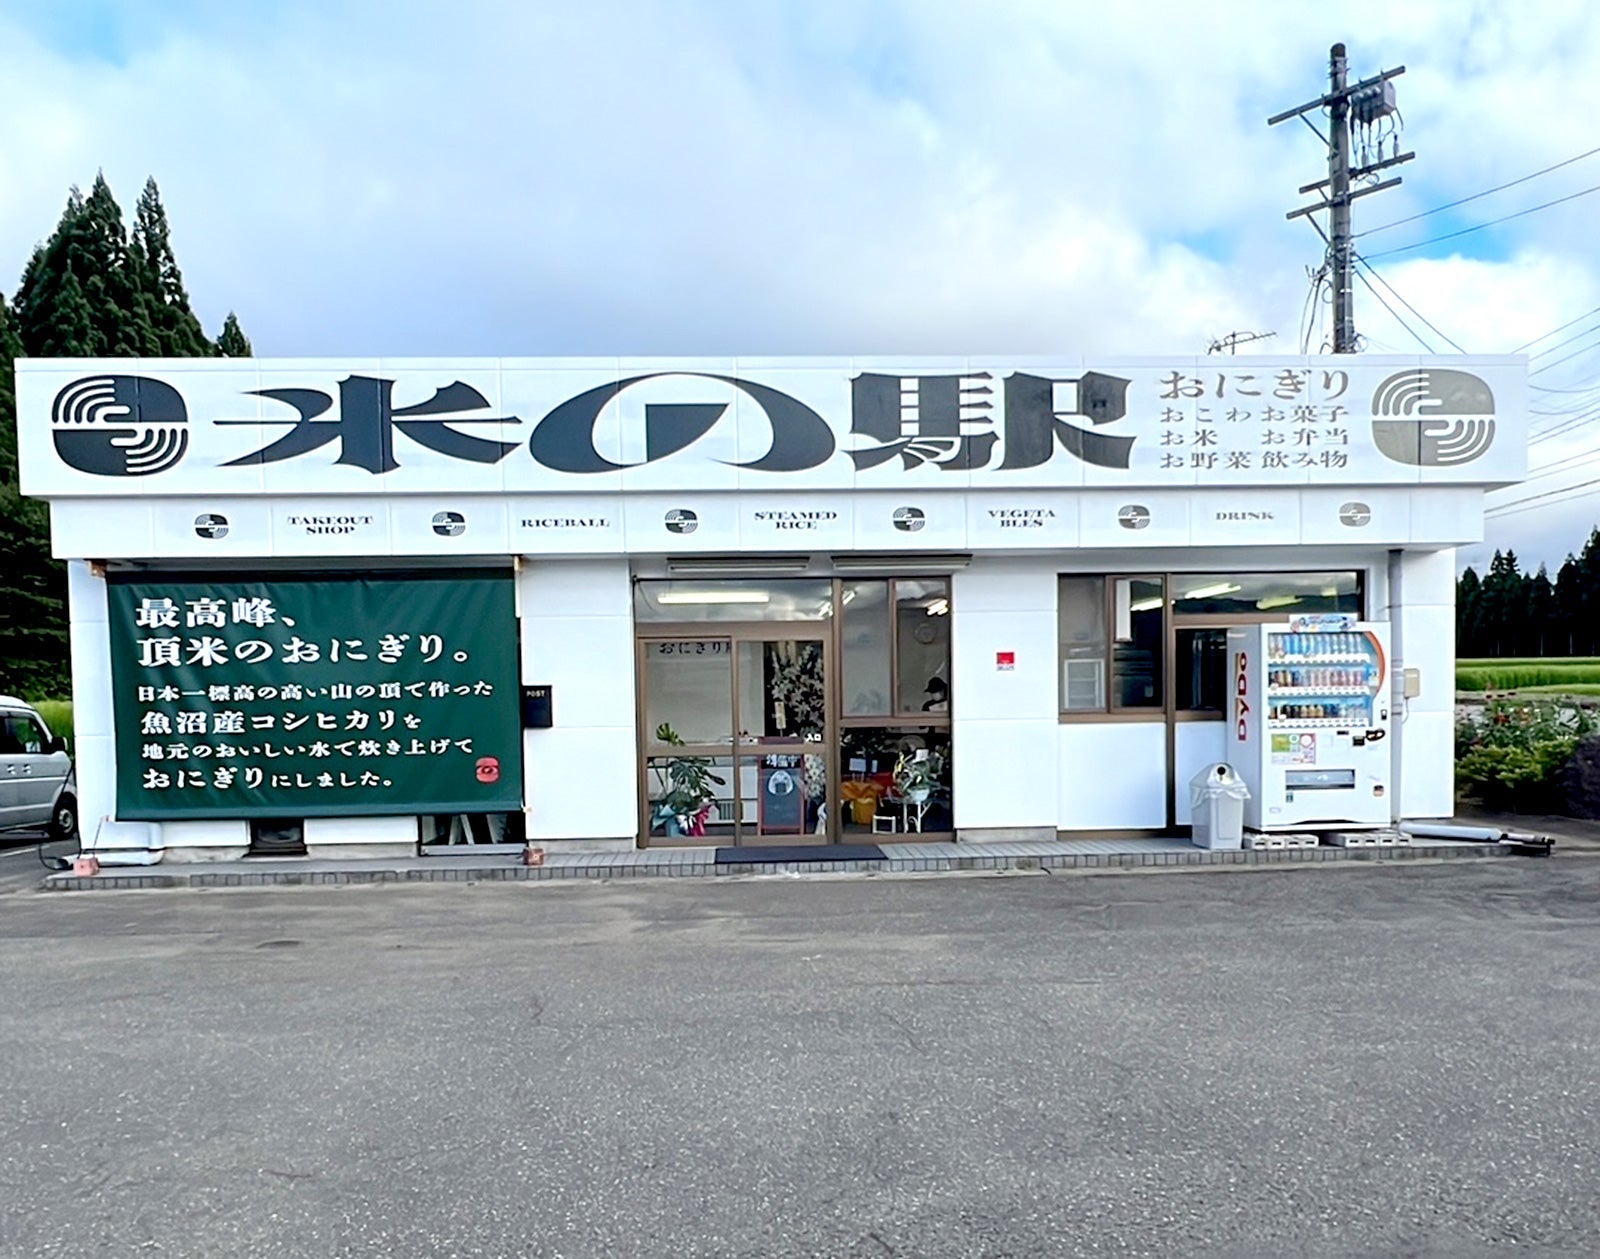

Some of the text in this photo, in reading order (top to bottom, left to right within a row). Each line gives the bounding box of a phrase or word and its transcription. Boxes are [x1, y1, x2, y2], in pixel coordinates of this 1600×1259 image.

[1159, 368, 1349, 401] おにぎり
[213, 370, 1137, 475] 米の駅
[1160, 405, 1349, 424] おこわ お菓子
[1160, 428, 1348, 447] お米 お弁当
[1160, 450, 1348, 470] お野菜 飲み物
[287, 516, 373, 525] TAKEOUT
[521, 518, 610, 528] RICEBALL
[754, 511, 837, 521] STEAMED
[987, 509, 1056, 518] VEGETA
[1215, 511, 1274, 521] DRINK
[306, 526, 355, 535] SHOP
[775, 521, 817, 530] RICE
[1000, 519, 1044, 528] BLES
[135, 597, 295, 629] 最高峰、
[136, 634, 468, 667] 頂米のおにぎり。
[141, 709, 422, 735] 魚沼産コシヒカリを
[143, 766, 392, 791] おにぎりにしました。
